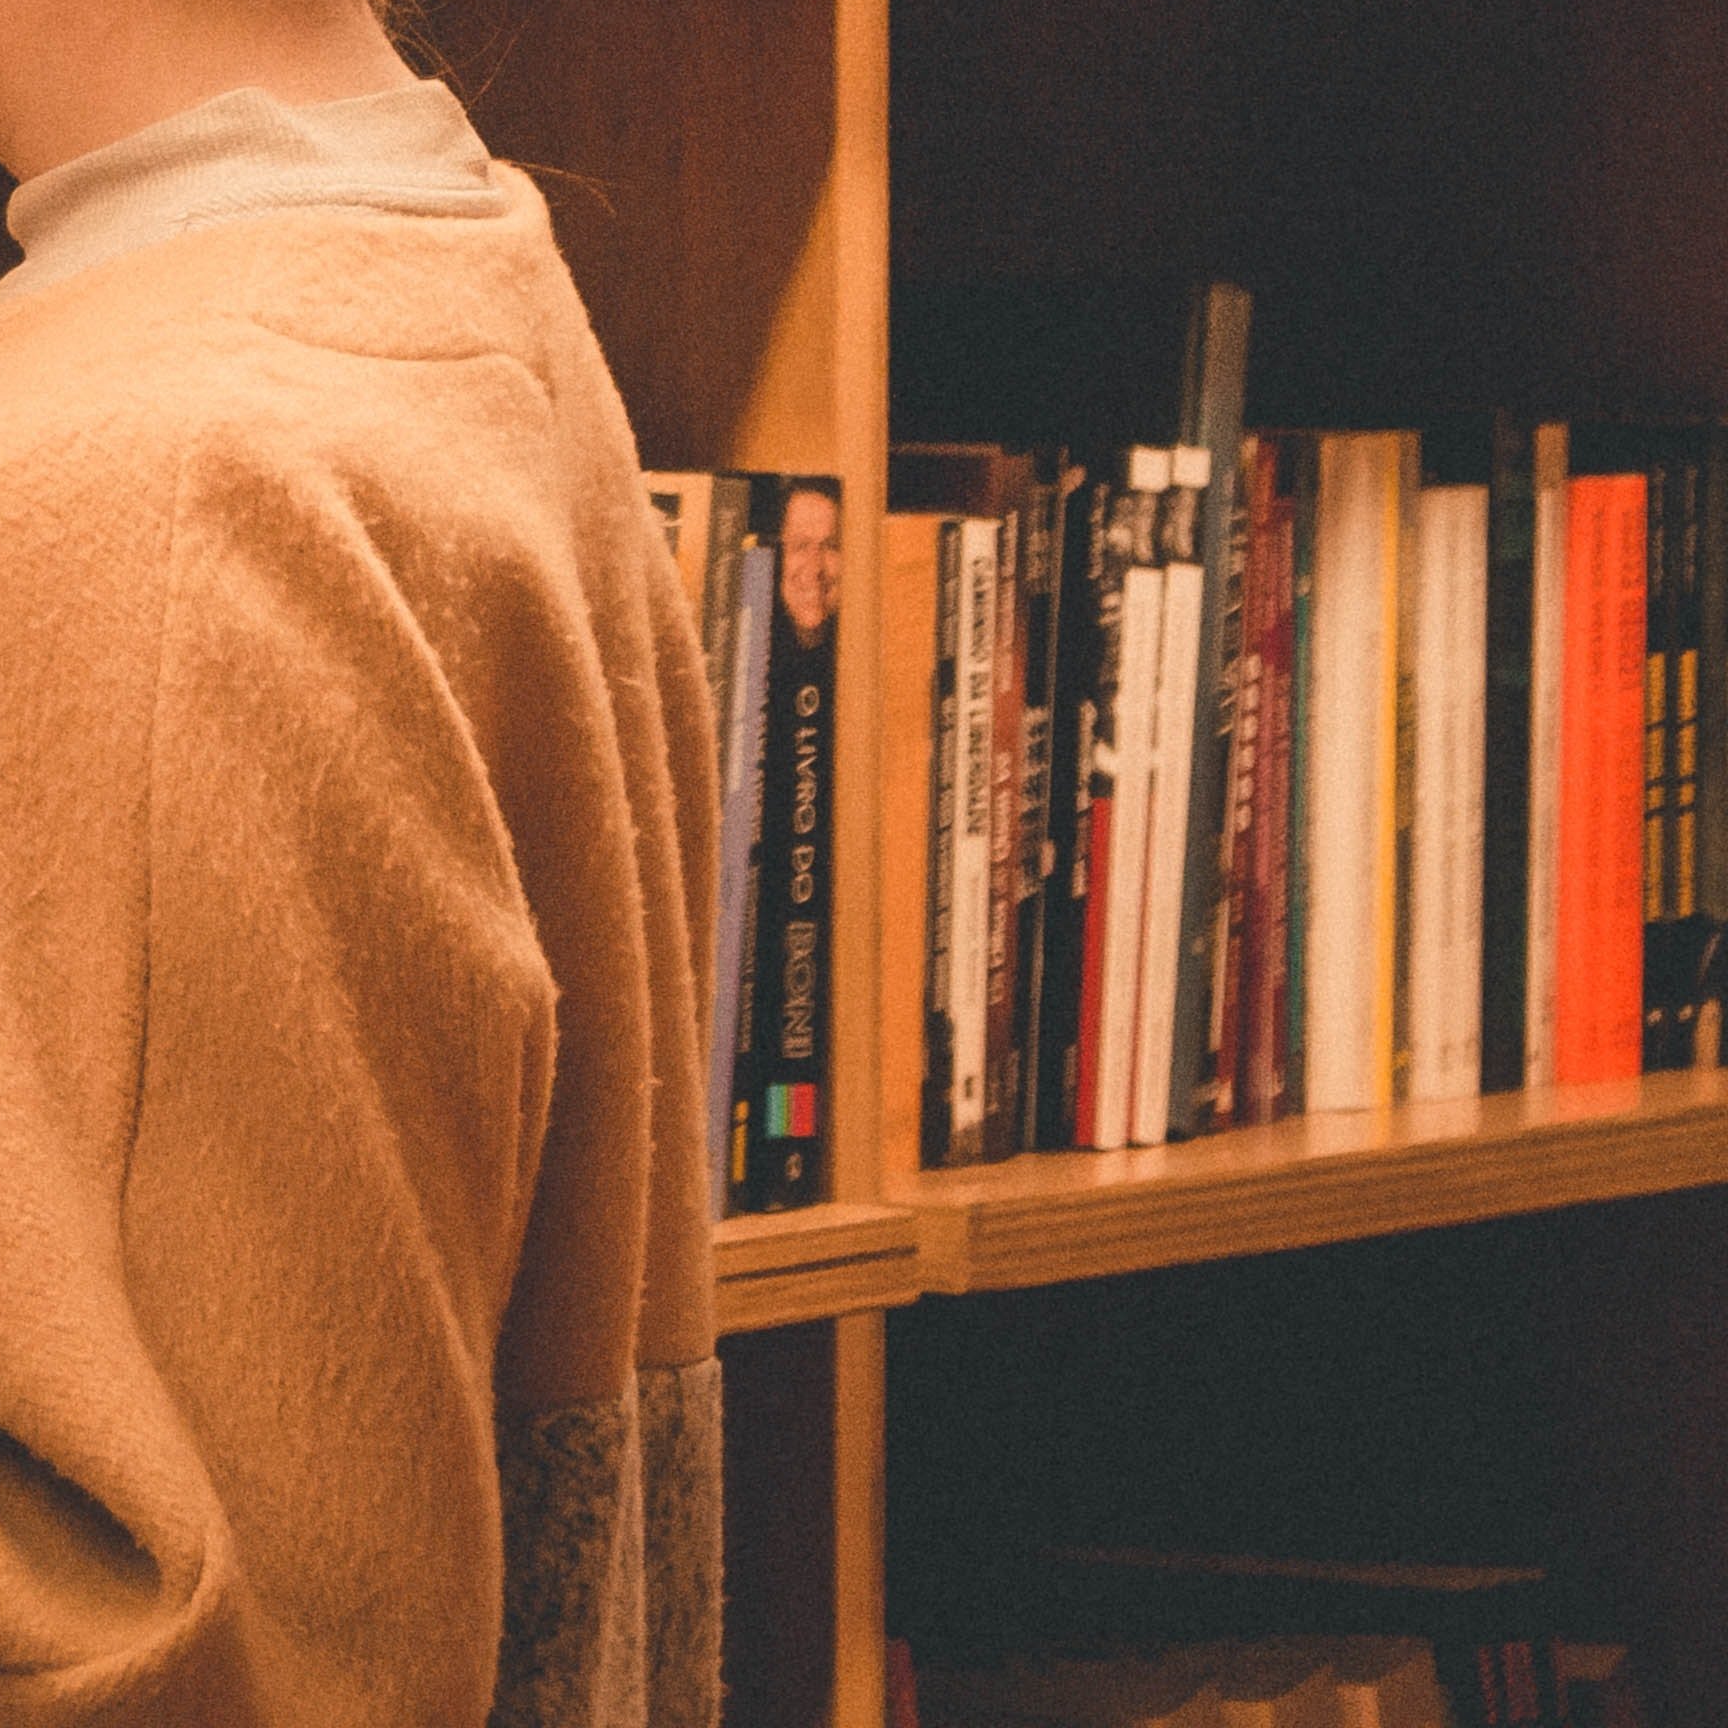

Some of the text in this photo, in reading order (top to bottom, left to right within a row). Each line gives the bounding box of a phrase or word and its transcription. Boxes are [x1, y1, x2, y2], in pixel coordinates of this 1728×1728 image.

[793, 683, 820, 718] O
[793, 727, 817, 834] LIVRO
[791, 842, 814, 906] DO
